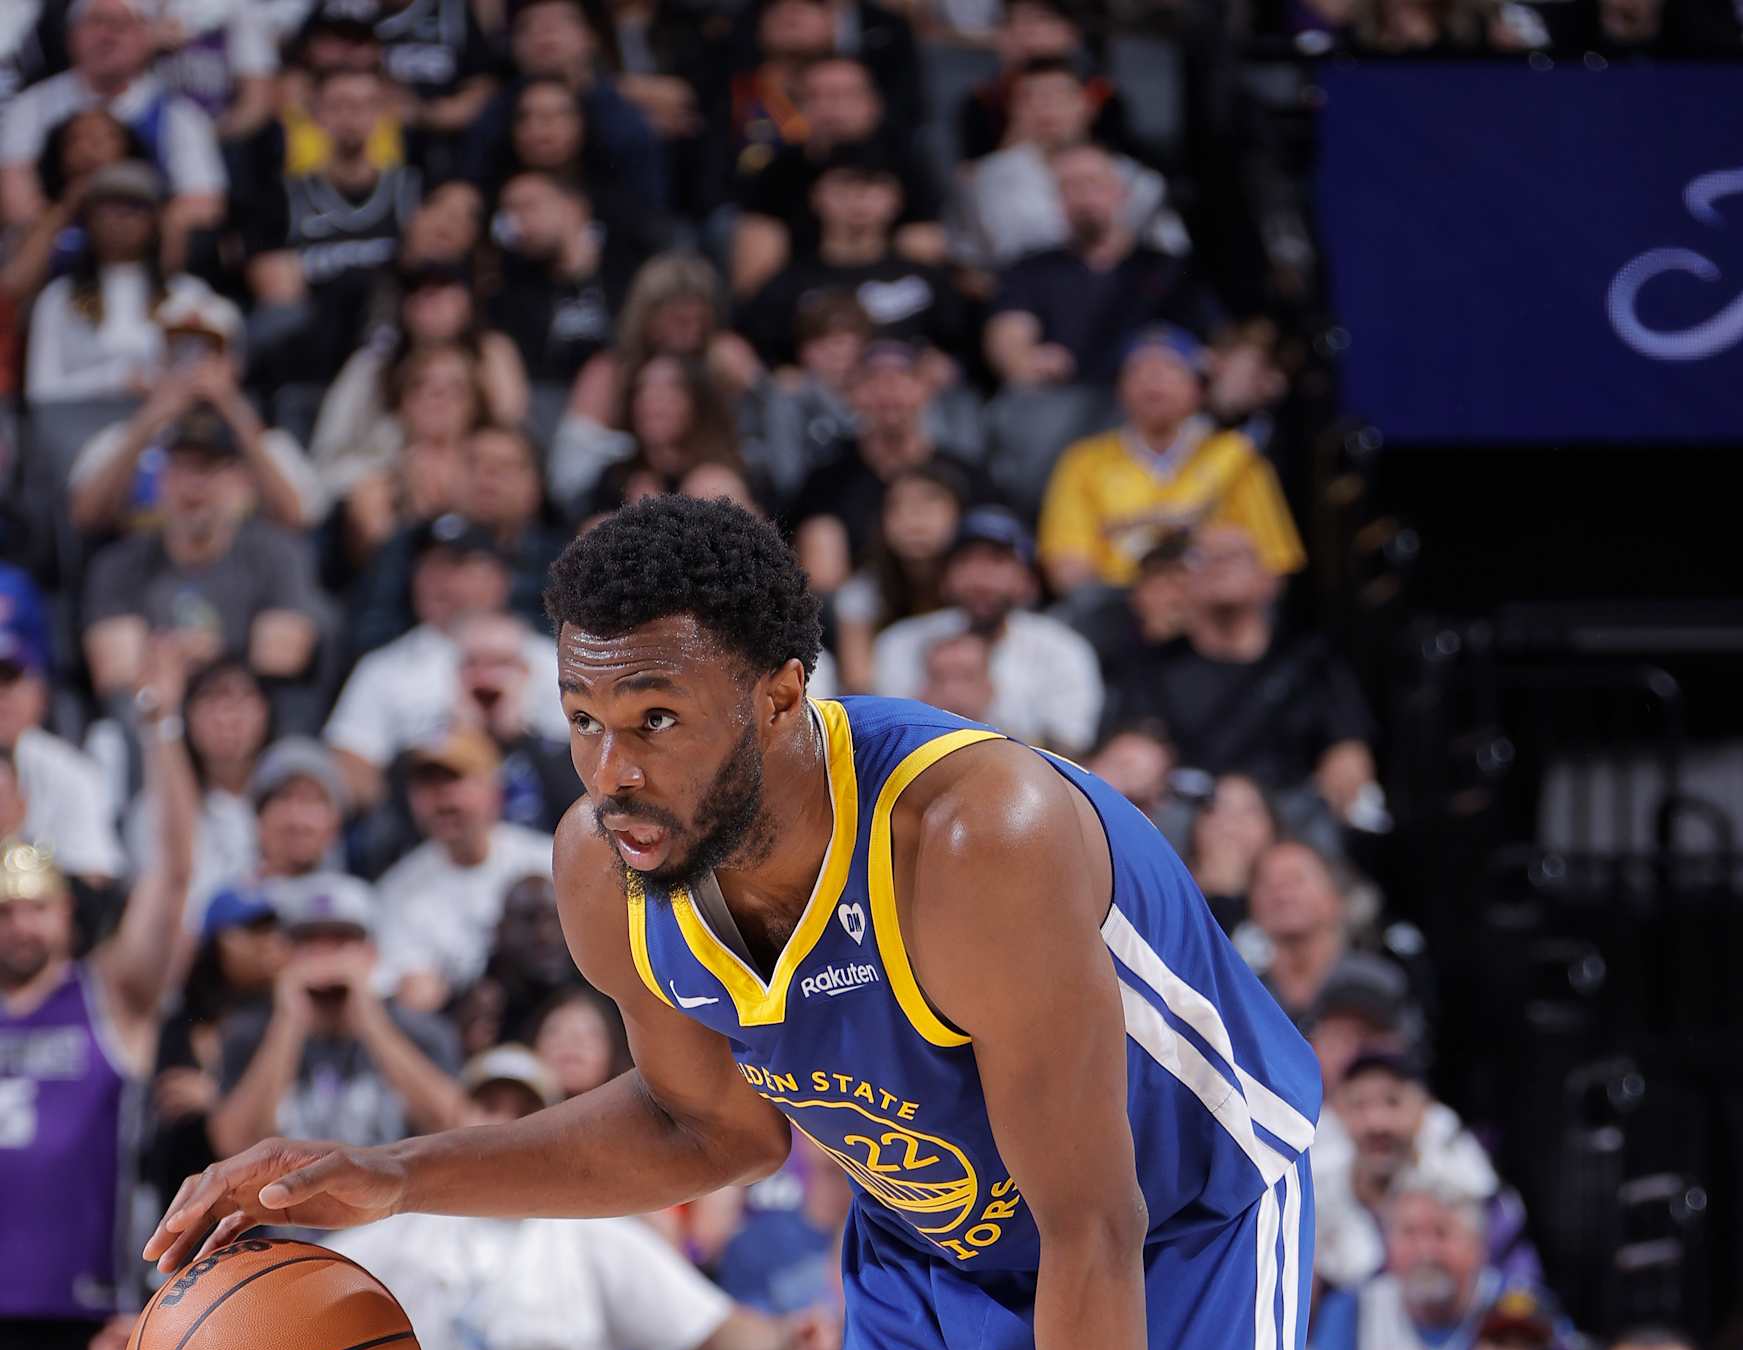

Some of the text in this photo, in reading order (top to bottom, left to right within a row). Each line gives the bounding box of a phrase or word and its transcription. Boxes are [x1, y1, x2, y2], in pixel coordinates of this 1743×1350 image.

[846, 913, 862, 932] DM
[800, 963, 880, 999] Rakuten
[736, 1062, 920, 1121] LDEN STATE
[843, 1131, 941, 1173] 22
[940, 1177, 1020, 1261] IORS
